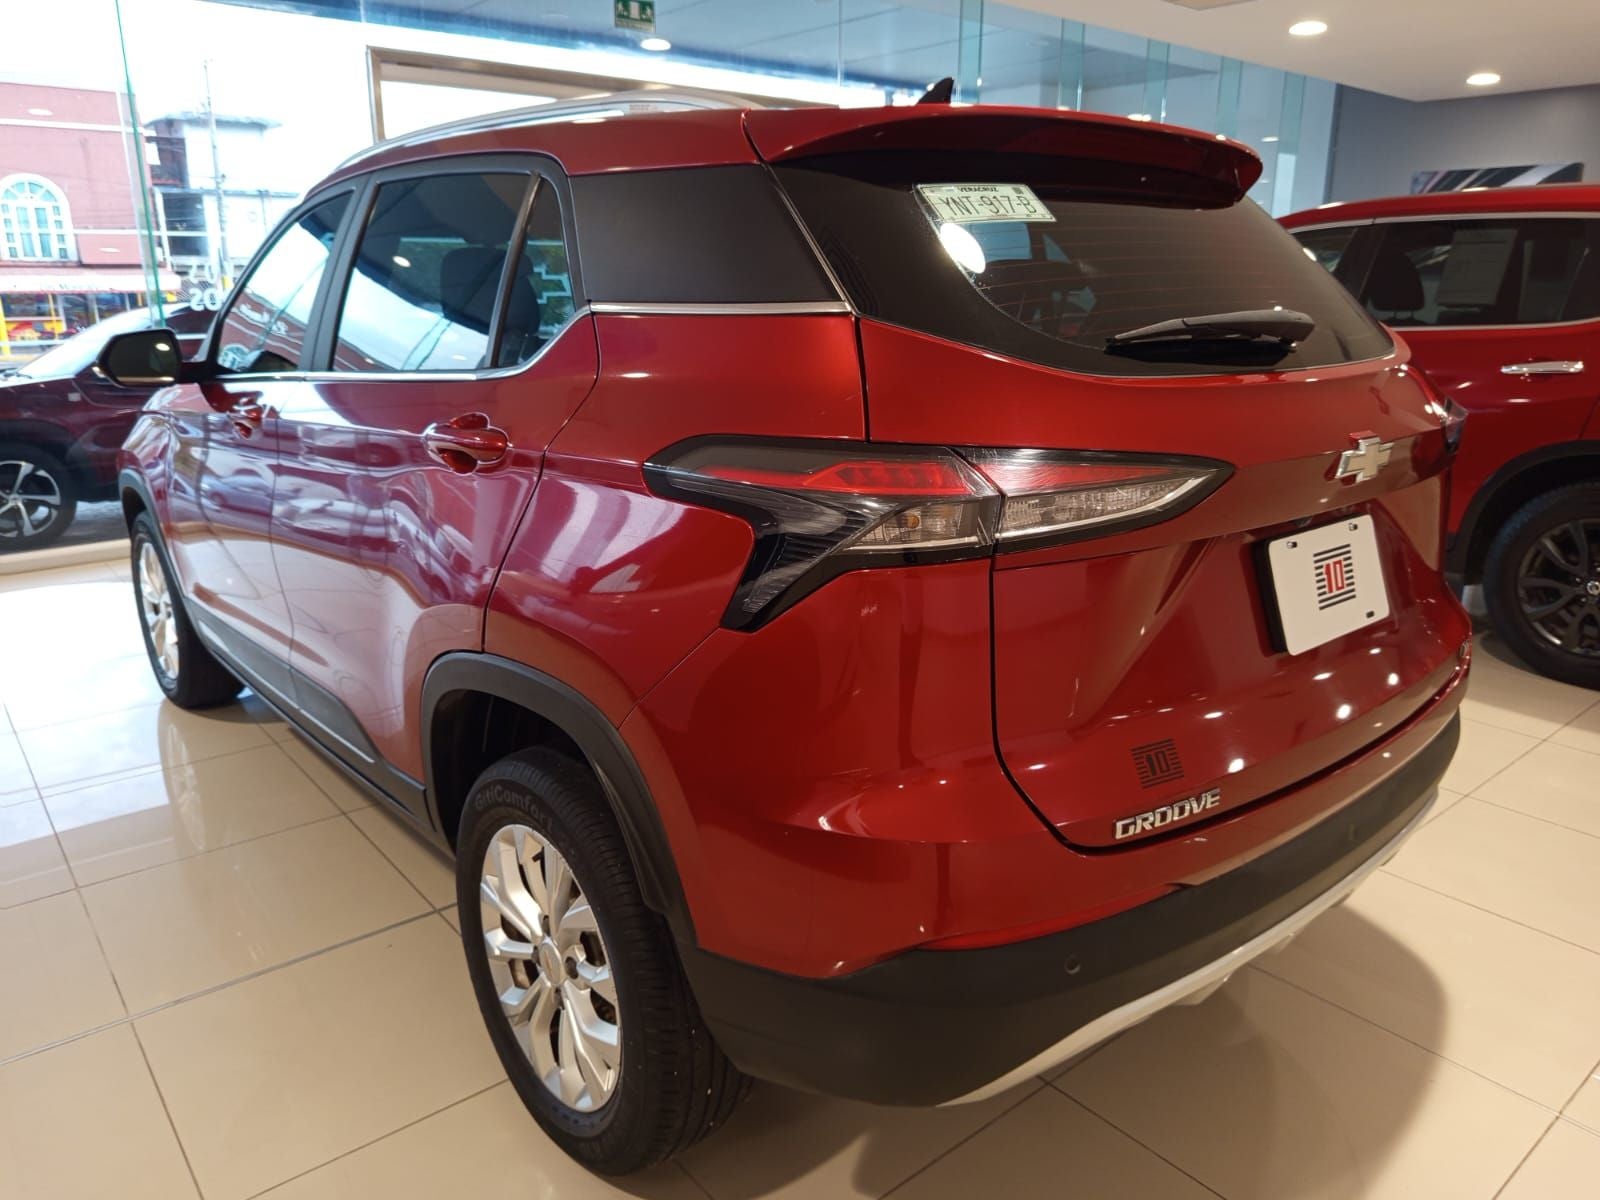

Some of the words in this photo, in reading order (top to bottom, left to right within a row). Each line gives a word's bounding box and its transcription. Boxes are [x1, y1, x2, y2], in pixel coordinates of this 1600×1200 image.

[938, 195, 1037, 216] YNT-917-B
[1324, 559, 1345, 594] 10
[1144, 749, 1170, 777] 10
[1114, 787, 1220, 840] GROOVE
